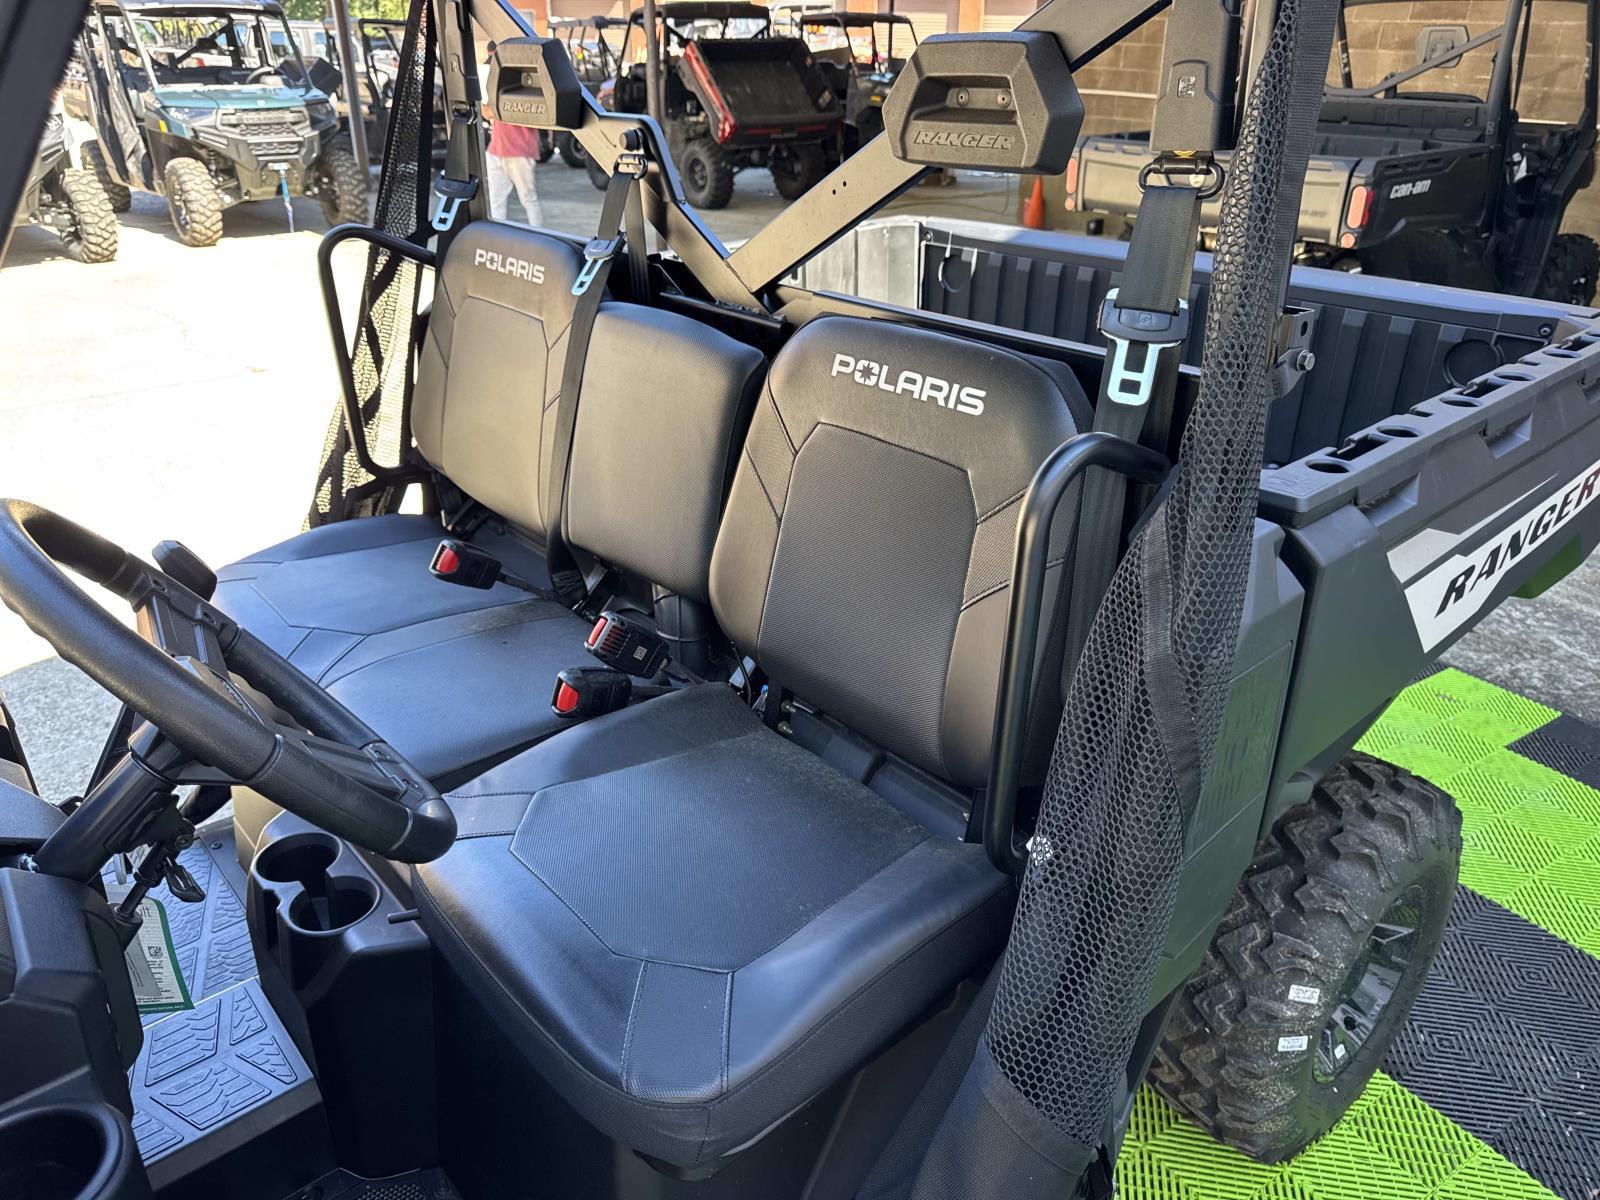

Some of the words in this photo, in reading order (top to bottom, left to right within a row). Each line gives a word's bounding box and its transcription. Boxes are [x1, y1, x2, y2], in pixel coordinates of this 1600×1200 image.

[503, 102, 546, 114] RANGER
[914, 130, 1014, 149] RANGER
[474, 248, 545, 285] POLARIS
[831, 353, 987, 416] POLARIS
[1434, 467, 1600, 618] RANGER
